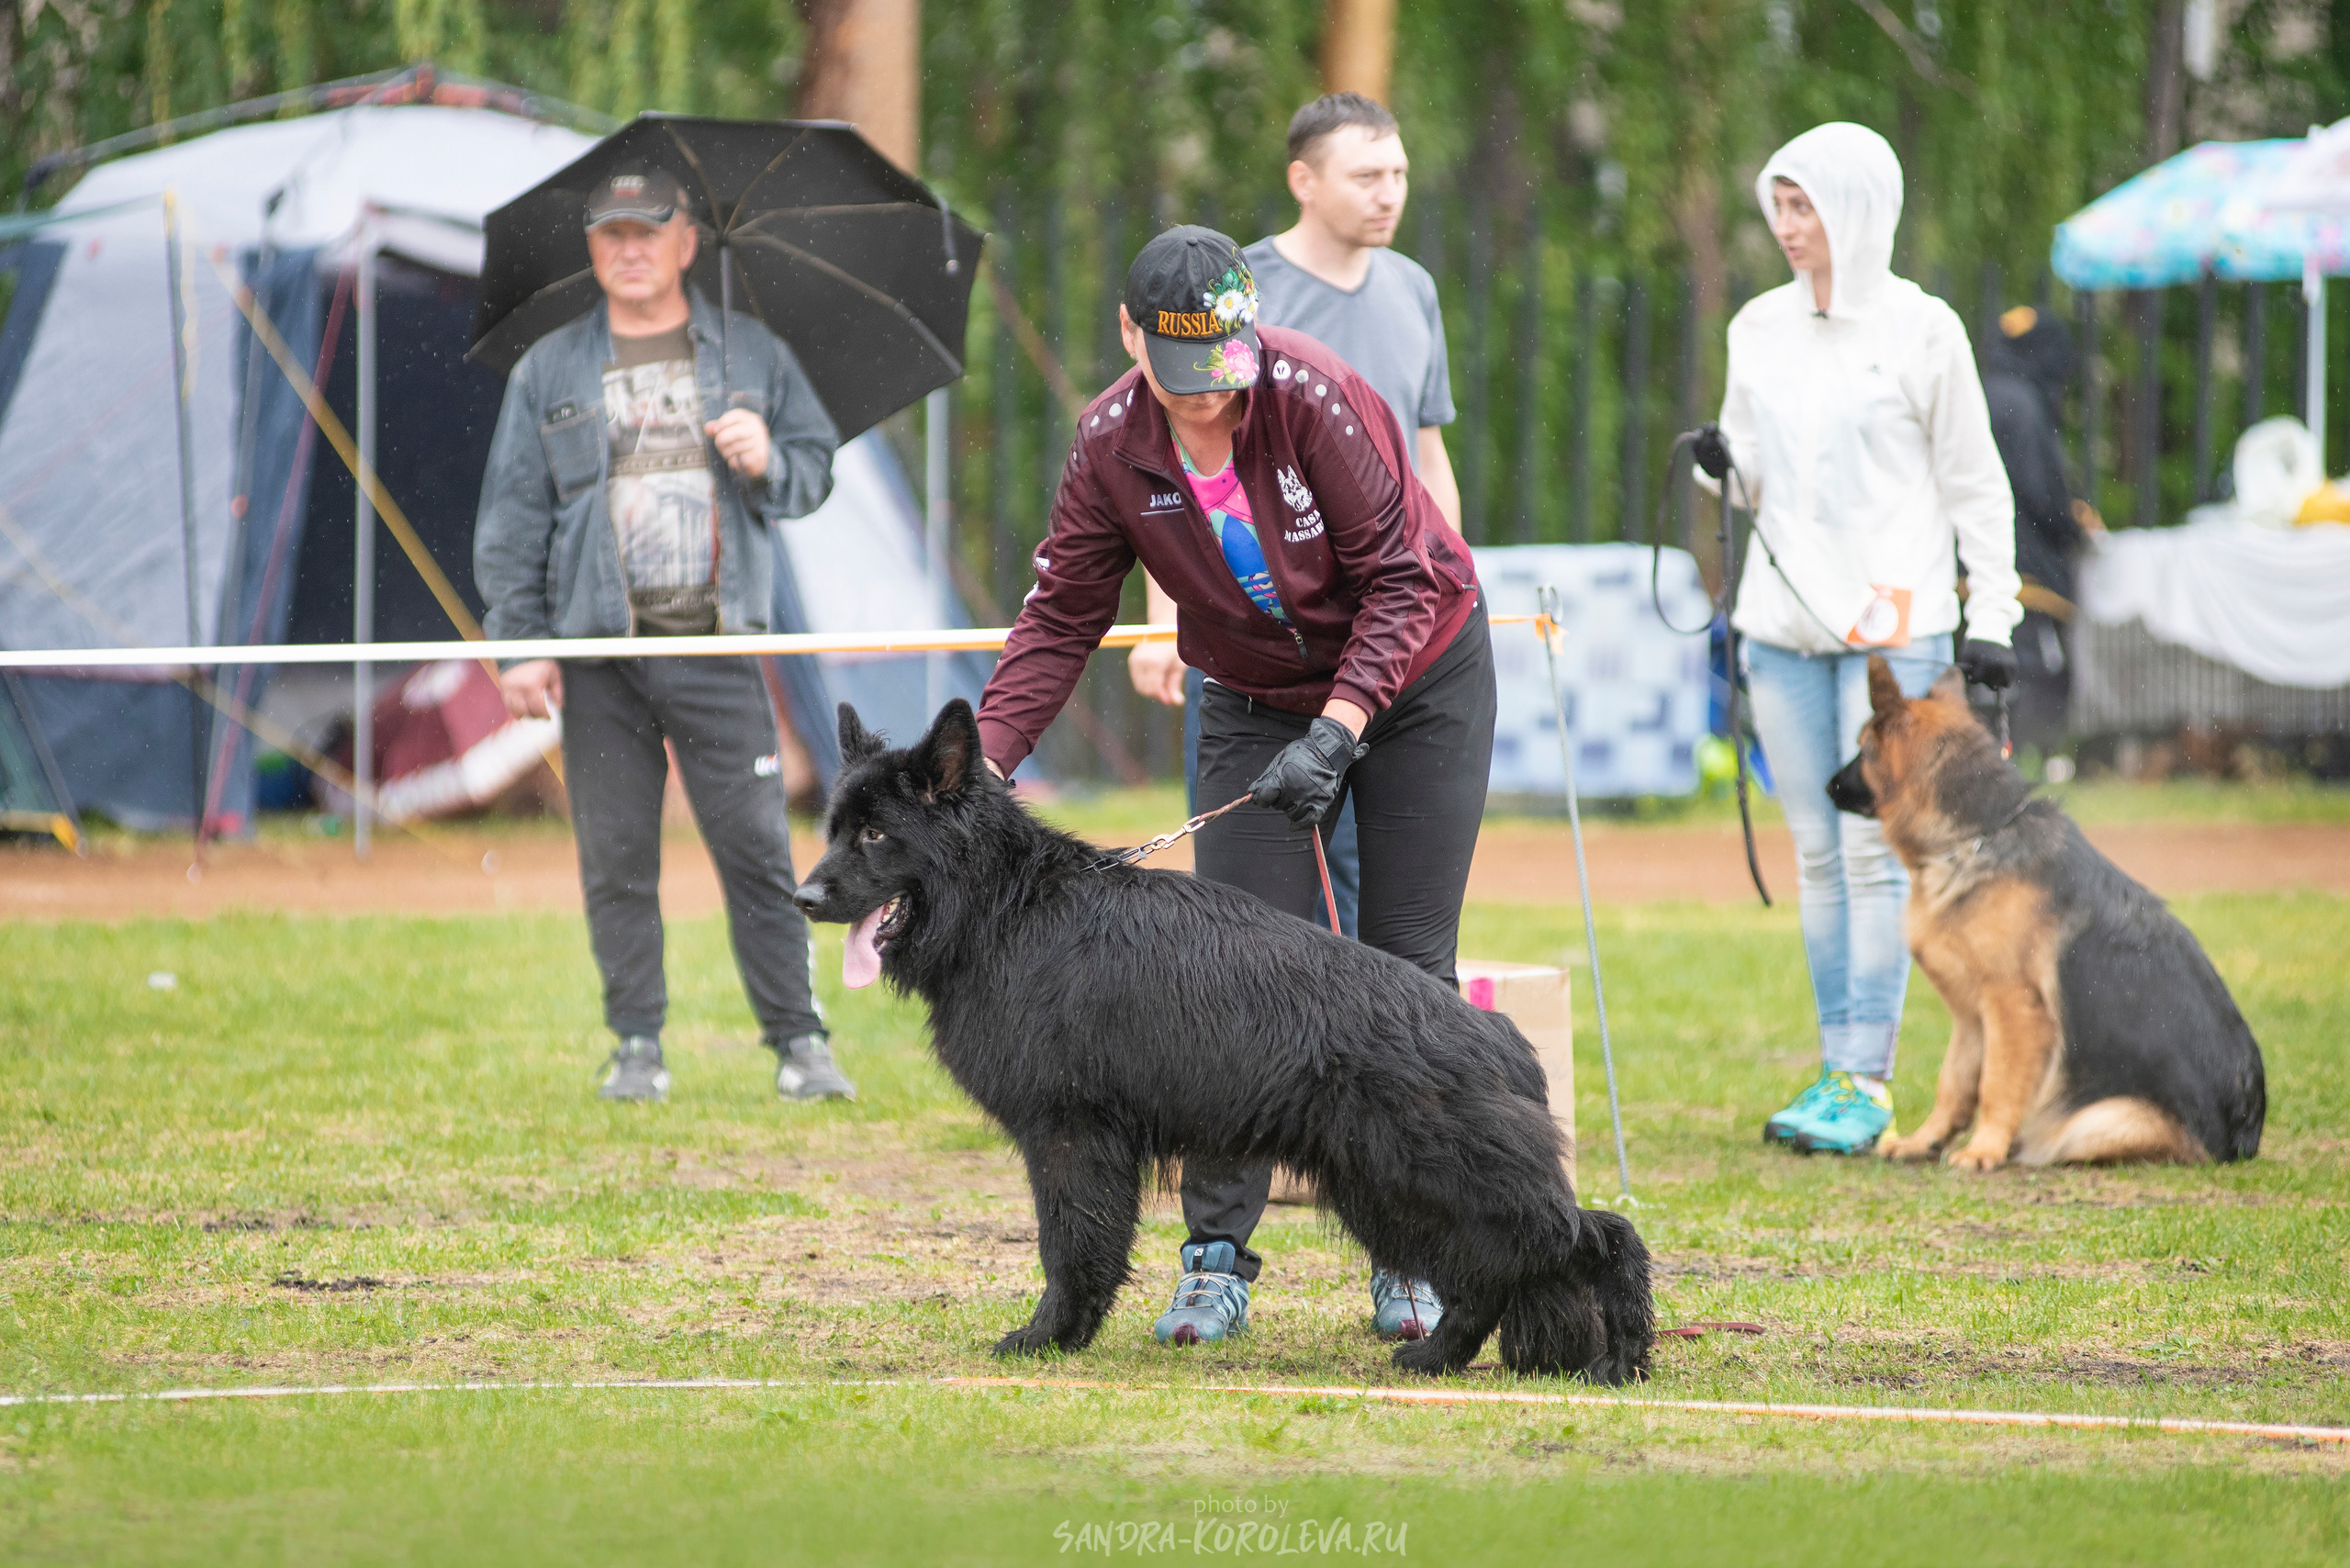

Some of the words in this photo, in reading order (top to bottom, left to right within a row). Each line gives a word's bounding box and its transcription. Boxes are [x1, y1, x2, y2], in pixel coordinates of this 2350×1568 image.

[1157, 309, 1222, 336] RUSSIA
[1149, 491, 1181, 507] JAKO
[1295, 509, 1321, 528] CASA
